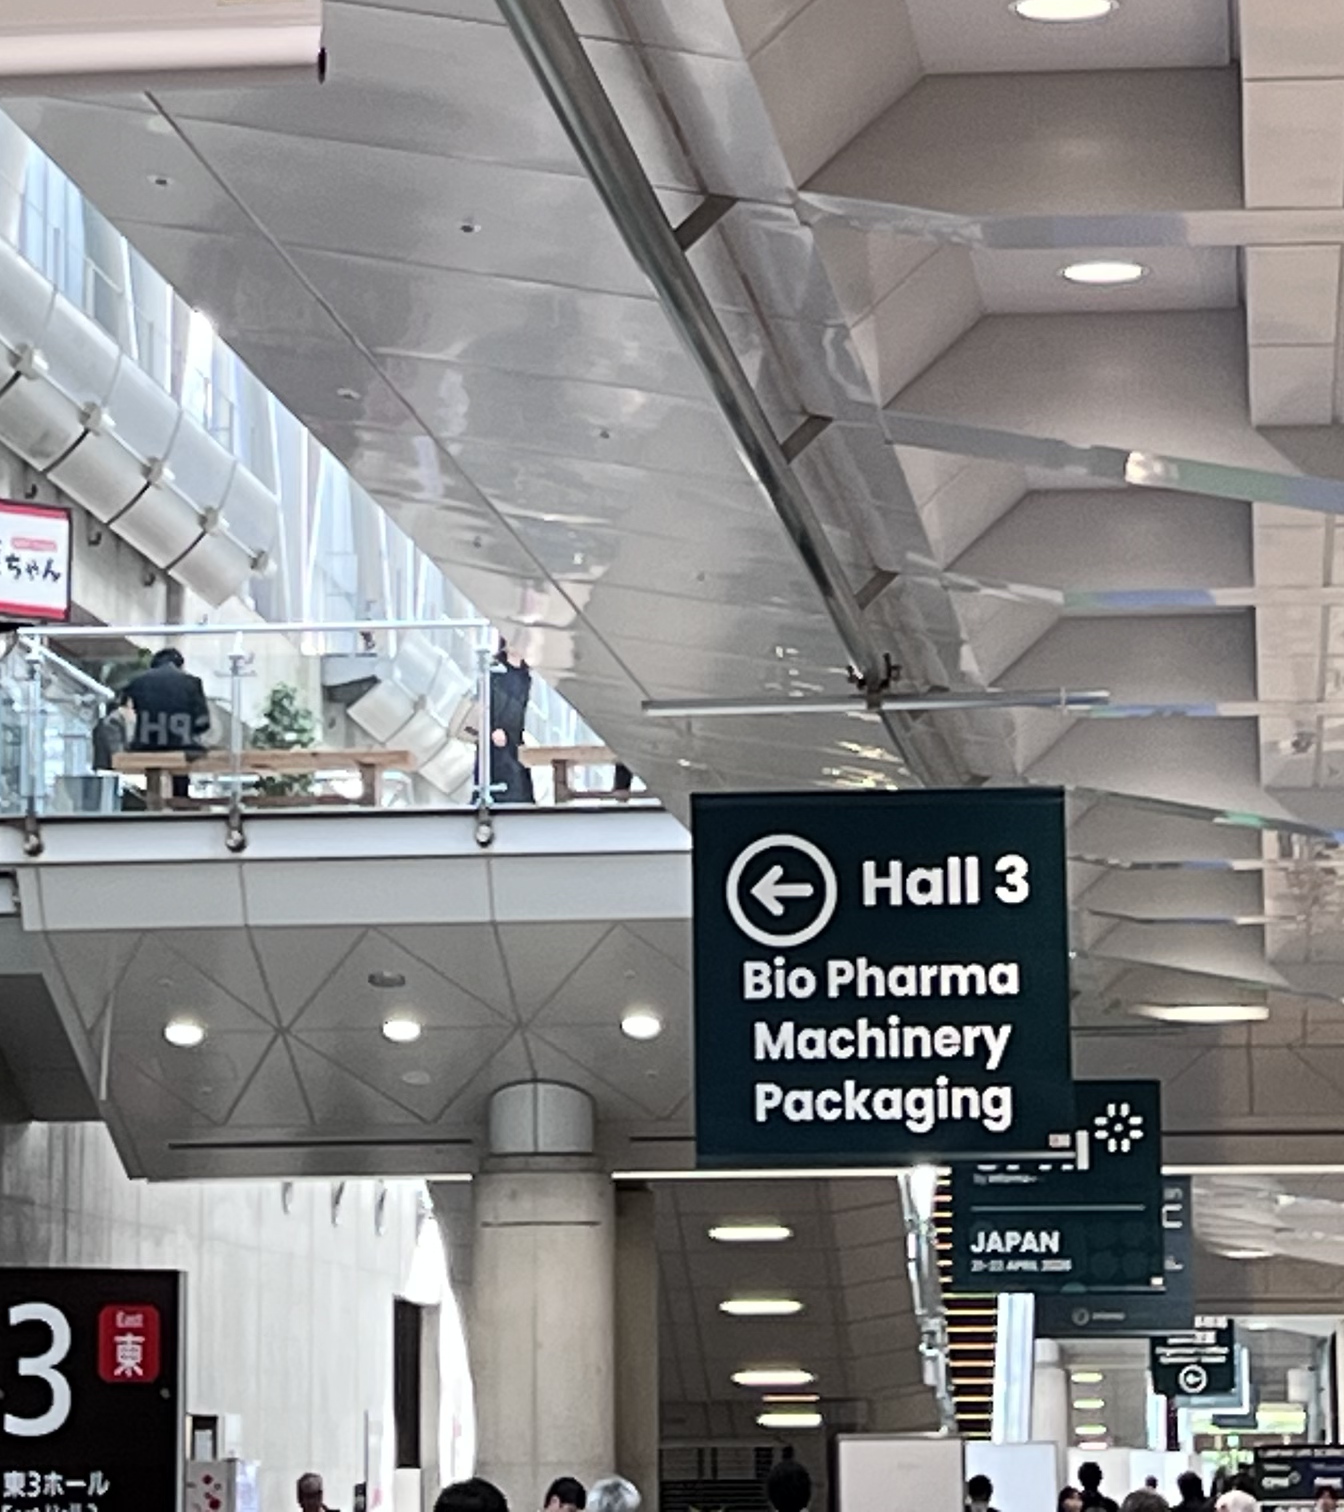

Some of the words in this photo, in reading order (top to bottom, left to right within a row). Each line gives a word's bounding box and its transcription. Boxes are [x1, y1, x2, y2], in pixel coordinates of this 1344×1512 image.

[862, 854, 981, 906] Hall
[994, 854, 1030, 904] 3
[743, 956, 817, 1000] Bio
[827, 956, 1021, 999] Pharma
[754, 1014, 1012, 1071] Machinery
[755, 1075, 1013, 1134] Packaging
[970, 1230, 1061, 1254] JAPAN
[115, 1311, 144, 1328] East
[3, 1302, 72, 1437] 3
[113, 1332, 146, 1378] 東
[2, 1470, 110, 1498] 東3ホール
